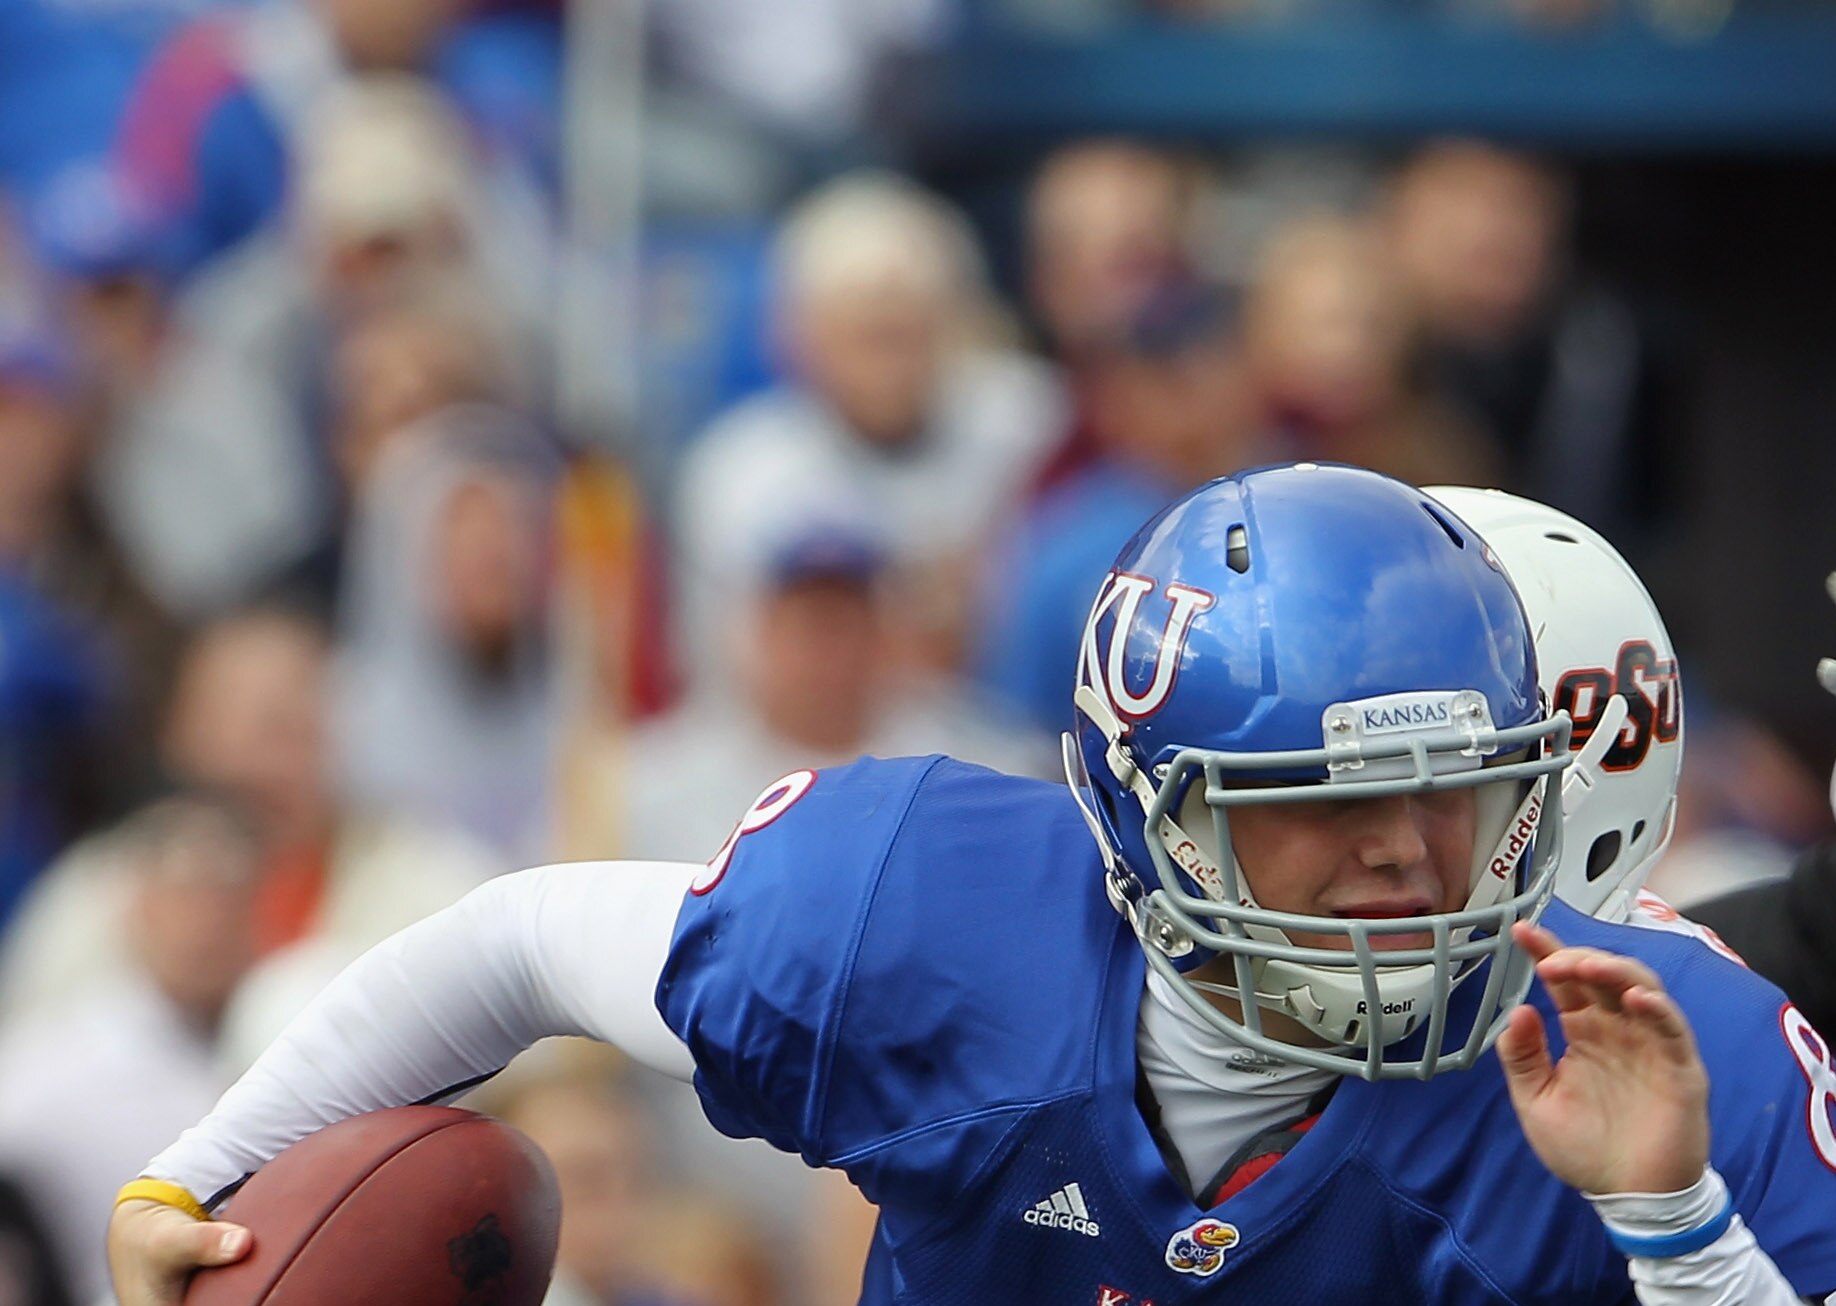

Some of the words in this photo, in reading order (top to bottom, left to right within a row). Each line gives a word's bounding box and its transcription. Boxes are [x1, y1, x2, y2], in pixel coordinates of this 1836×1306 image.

[1076, 572, 1219, 736] KU
[1363, 699, 1449, 730] KANSAS
[1490, 795, 1541, 881] Riddel
[1024, 1207, 1100, 1238] adidas
